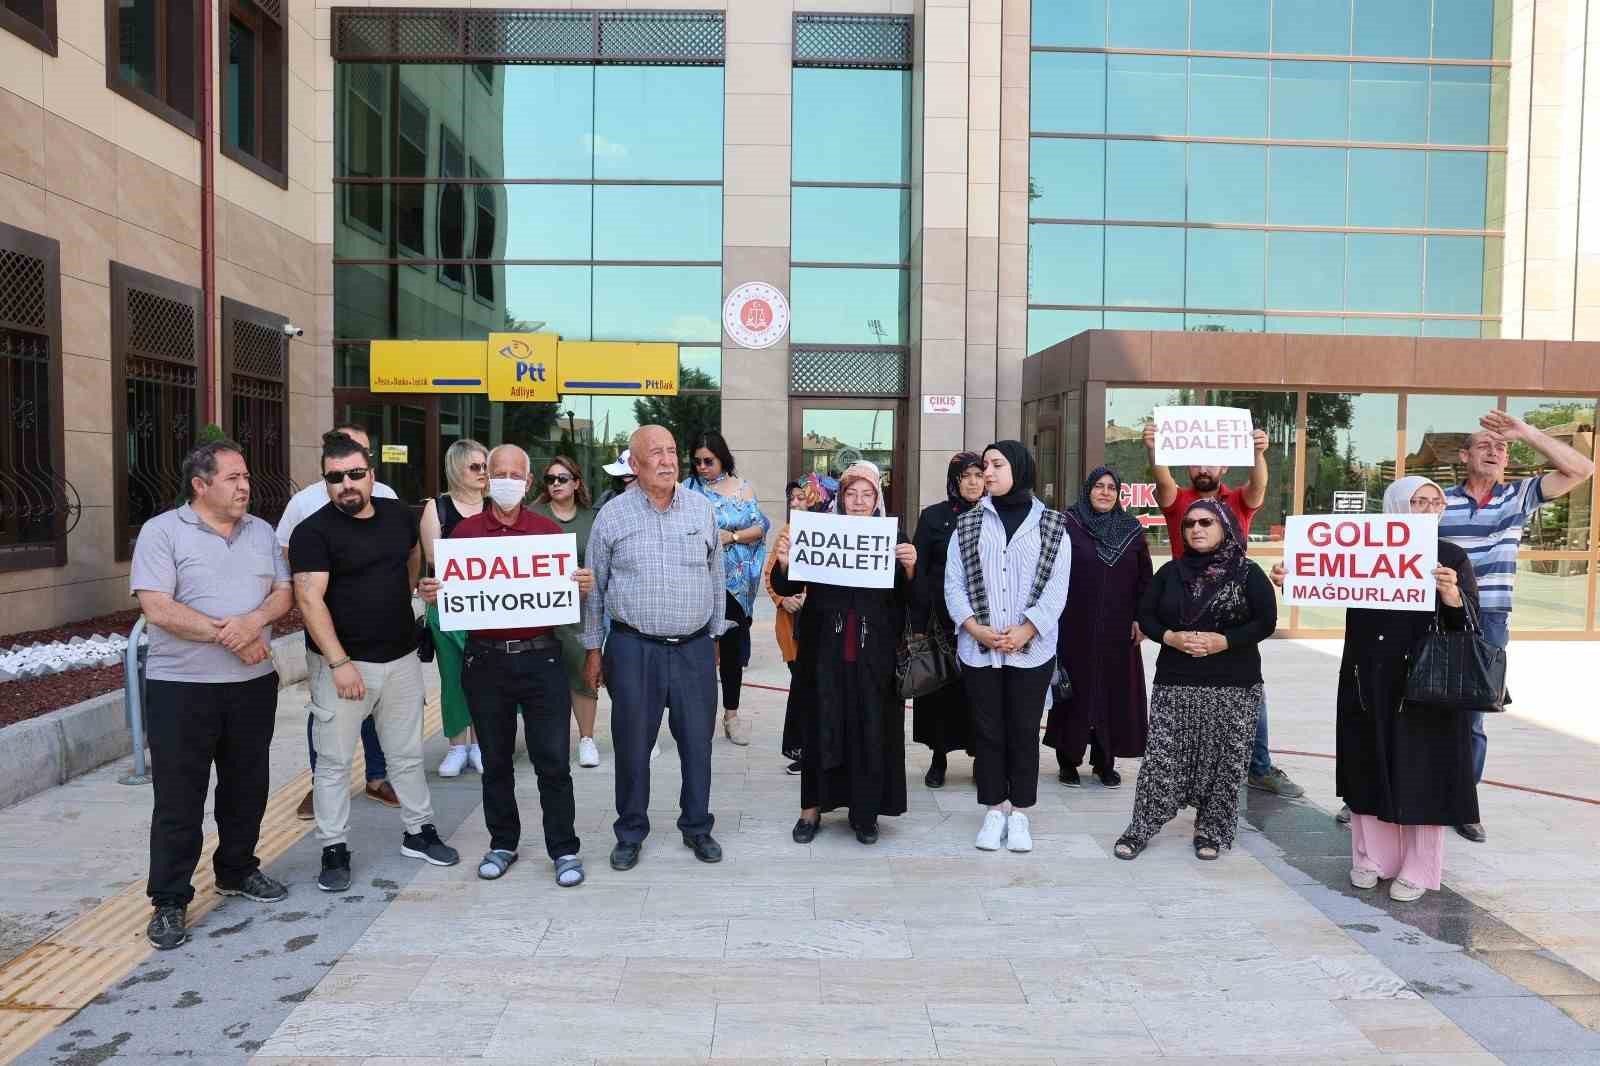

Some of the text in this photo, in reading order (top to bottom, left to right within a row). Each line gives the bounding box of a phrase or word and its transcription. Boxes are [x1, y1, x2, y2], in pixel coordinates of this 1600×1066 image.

[516, 361, 546, 382] Ptt
[511, 386, 535, 399] Adliye
[1160, 419, 1248, 433] ADALET!
[1161, 435, 1248, 450] ADALET!
[1119, 482, 1160, 512] ÇIK
[795, 530, 890, 551] ADALET!
[1307, 521, 1410, 547] GOLD
[442, 553, 571, 581] ADALET
[795, 549, 889, 570] ADALET!
[1295, 553, 1424, 579] EMLAK
[444, 590, 572, 613] İSTİYORUZ!
[1292, 584, 1426, 603] MAĞDURLARI
